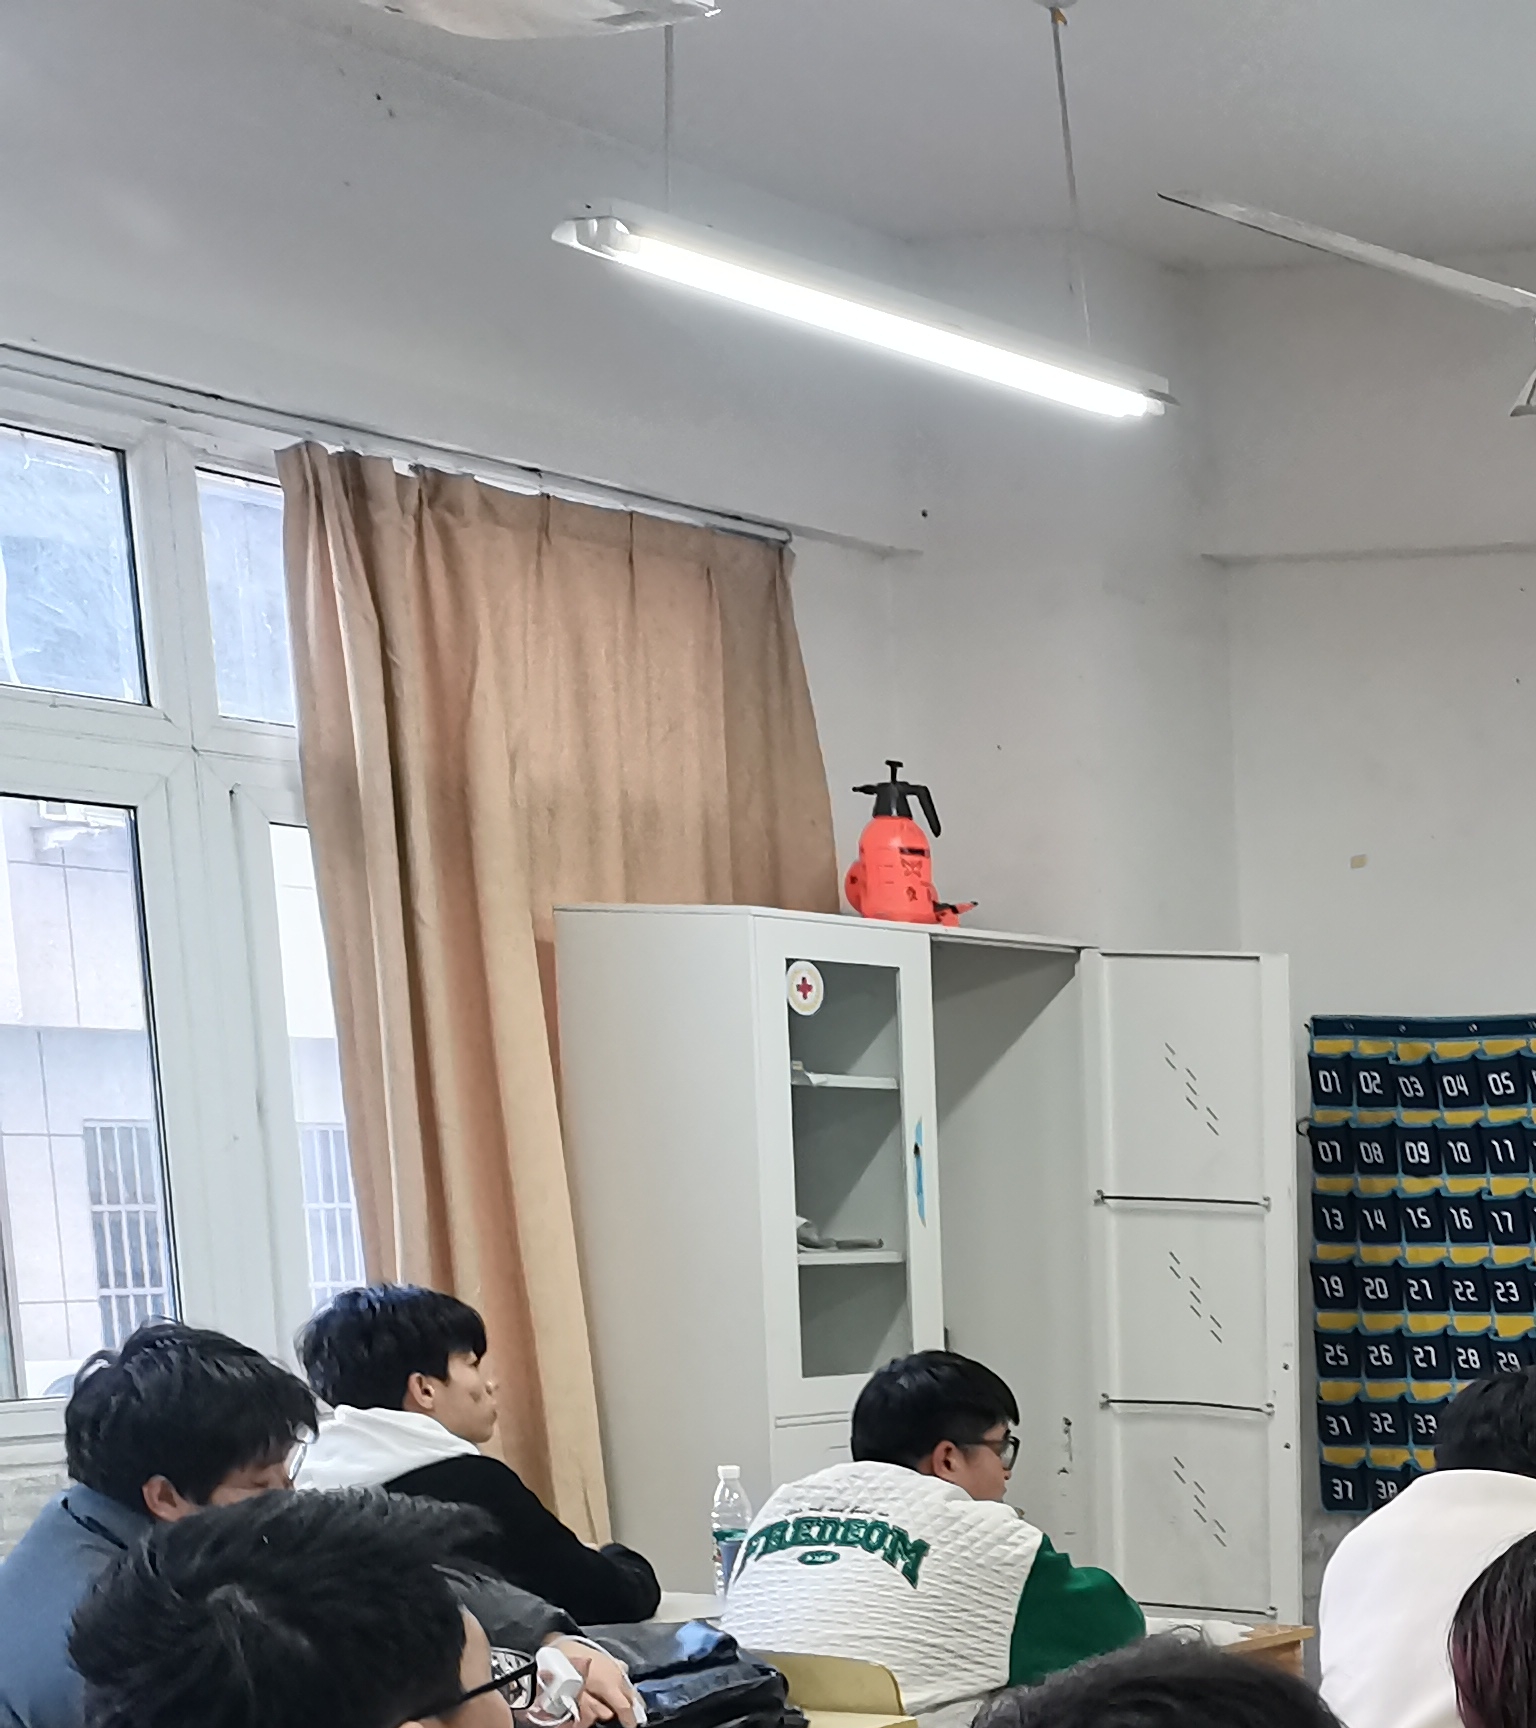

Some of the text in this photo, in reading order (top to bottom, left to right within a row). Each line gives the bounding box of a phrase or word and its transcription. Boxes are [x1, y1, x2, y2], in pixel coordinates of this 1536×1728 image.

[1318, 1070, 1342, 1093] 01
[1358, 1071, 1383, 1094] 02
[1398, 1076, 1424, 1097] 03
[1442, 1074, 1469, 1097] 04
[1487, 1071, 1515, 1096] 05
[1318, 1141, 1341, 1162] 07
[1359, 1142, 1384, 1163] 08
[1404, 1141, 1430, 1164] 09
[1447, 1141, 1472, 1163] 10
[1490, 1139, 1516, 1162] 11
[1322, 1208, 1344, 1230] 13
[1362, 1209, 1387, 1230] 14
[1406, 1207, 1432, 1229] 15
[1449, 1207, 1473, 1230] 16
[1491, 1211, 1514, 1233] 17
[1320, 1276, 1344, 1297] 19
[1363, 1277, 1389, 1299] 20
[1407, 1278, 1433, 1300] 21
[1452, 1280, 1479, 1302] 22
[1494, 1280, 1520, 1303] 23
[1324, 1344, 1349, 1365] 25
[1367, 1344, 1393, 1366] 26
[1412, 1345, 1437, 1368] 27
[1456, 1347, 1481, 1369] 28
[1496, 1351, 1521, 1372] 29
[1327, 1412, 1438, 1435] 31 32 33
[1332, 1478, 1353, 1500] 37
